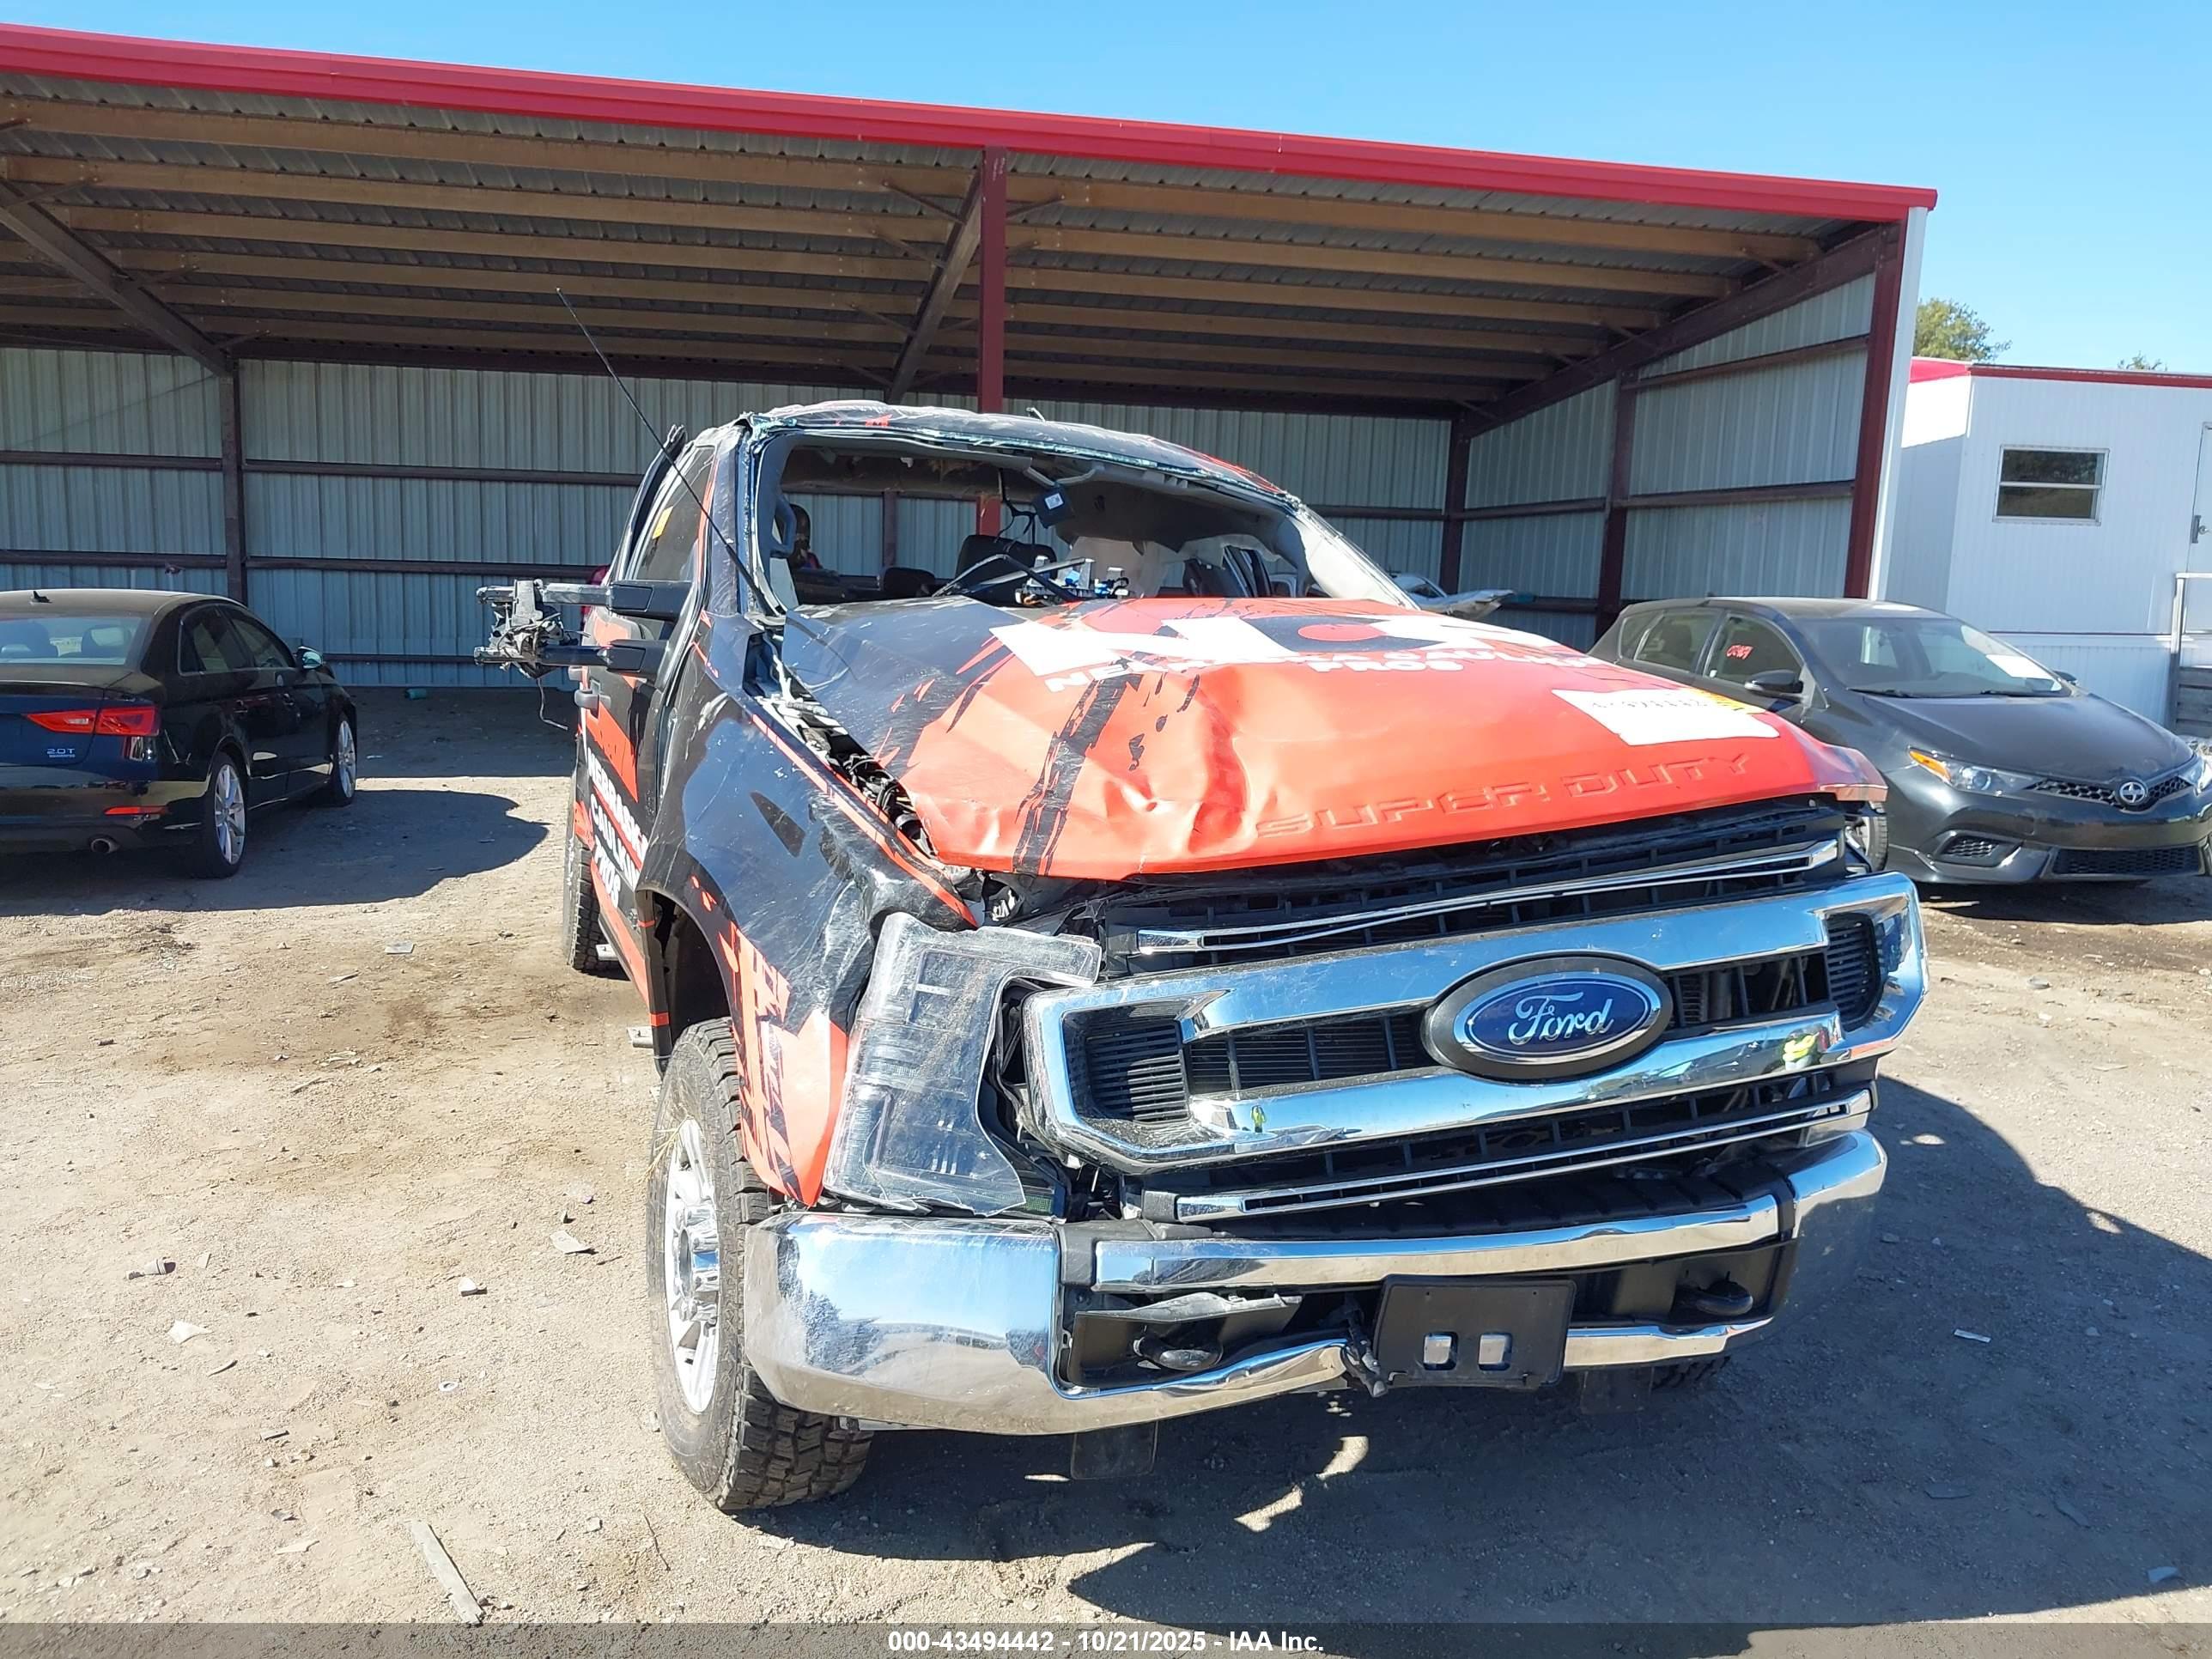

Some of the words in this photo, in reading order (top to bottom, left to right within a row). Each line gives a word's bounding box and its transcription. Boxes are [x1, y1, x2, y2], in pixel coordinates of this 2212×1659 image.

[1256, 781, 1552, 839] SUPER
[1560, 752, 1751, 799] DUTY
[1508, 991, 1615, 1046] Ford
